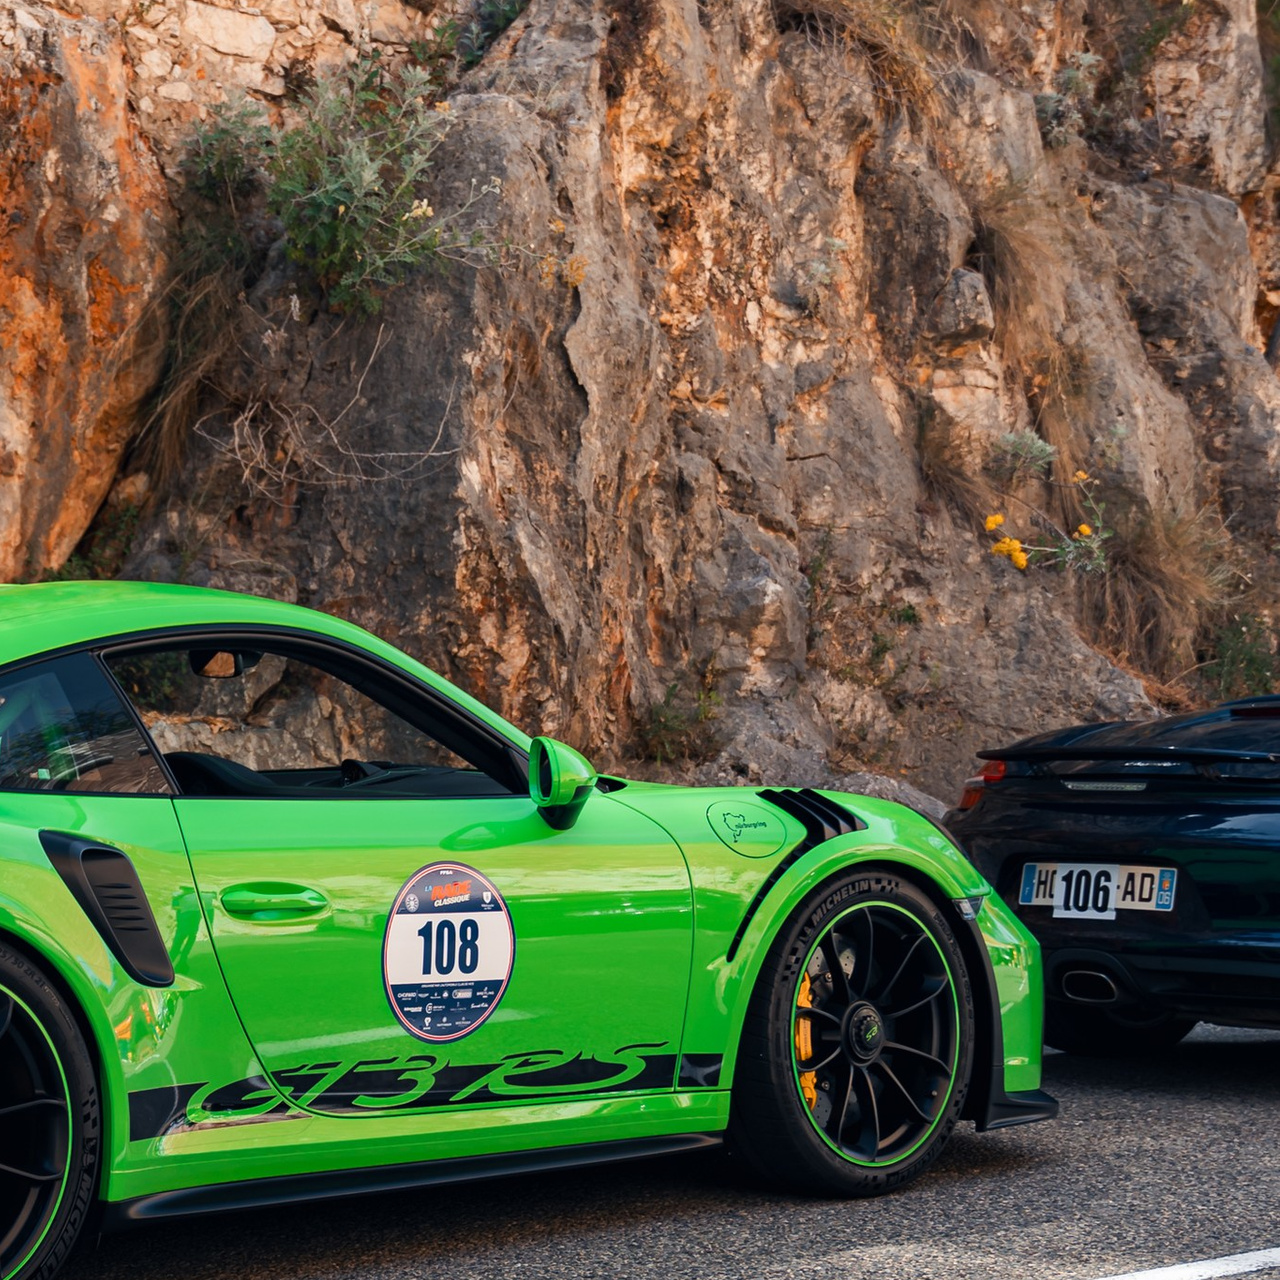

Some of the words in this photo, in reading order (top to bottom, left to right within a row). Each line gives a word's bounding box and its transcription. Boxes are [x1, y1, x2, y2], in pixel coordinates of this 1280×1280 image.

[433, 894, 471, 907] CLASSIQUE
[811, 880, 870, 926] MICHELIN
[1061, 869, 1112, 913] 106
[1158, 891, 1171, 905] 06
[417, 918, 480, 976] 108
